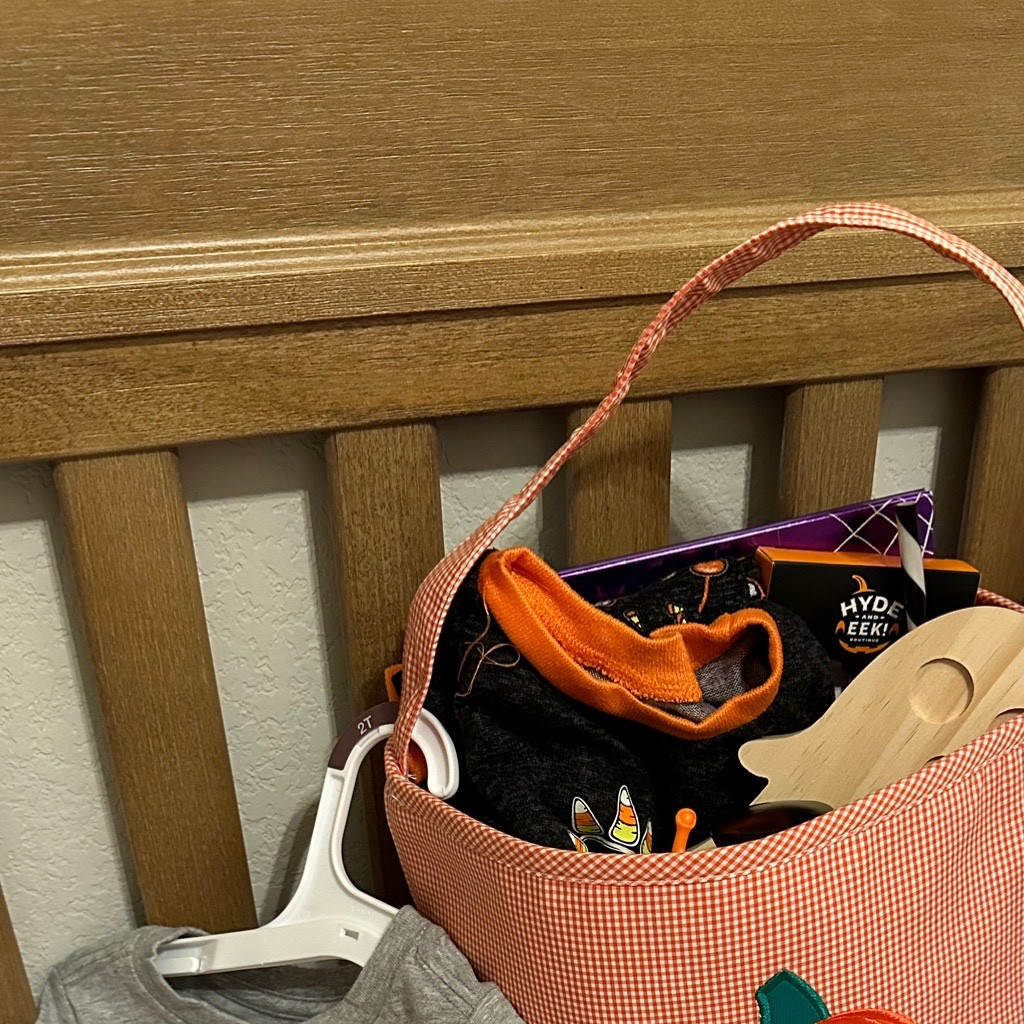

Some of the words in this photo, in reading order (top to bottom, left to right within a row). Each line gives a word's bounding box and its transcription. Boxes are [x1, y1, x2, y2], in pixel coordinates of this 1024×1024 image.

[840, 595, 904, 618] HYDE
[847, 621, 889, 637] EEK!
[357, 715, 373, 736] 2T
